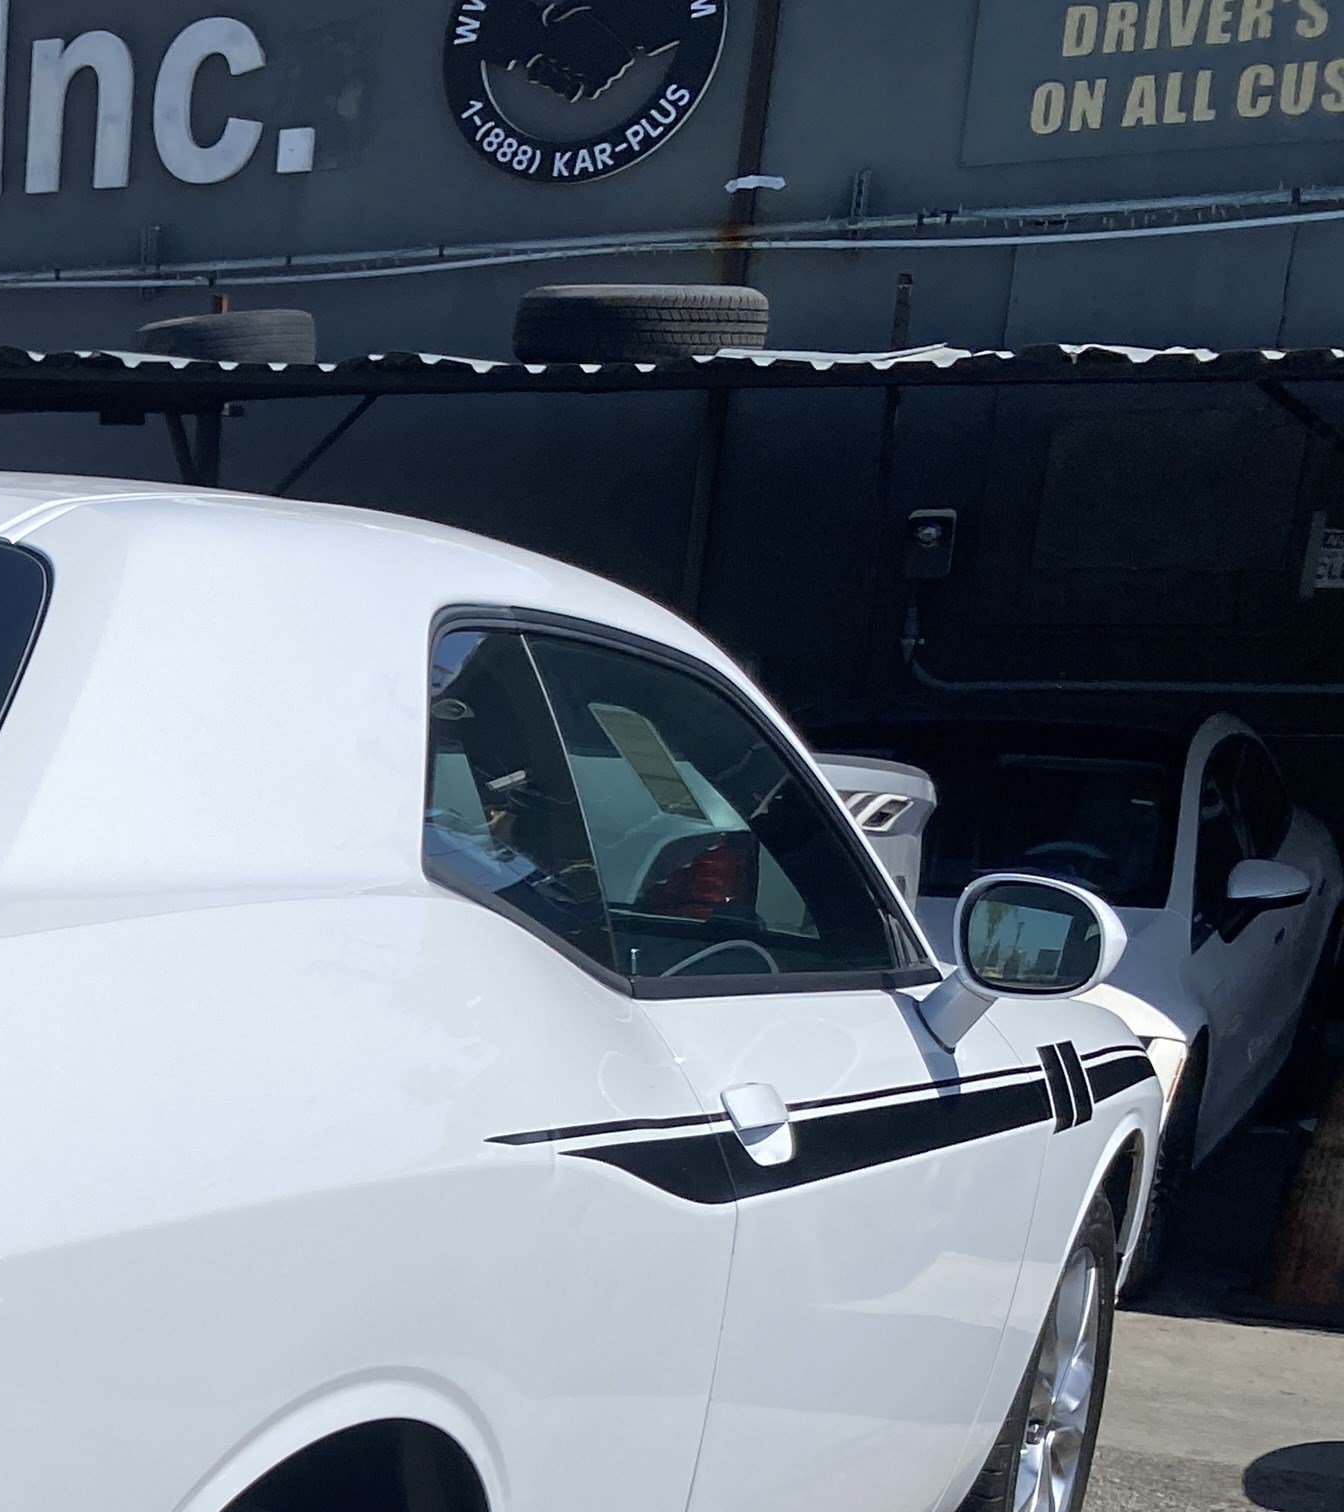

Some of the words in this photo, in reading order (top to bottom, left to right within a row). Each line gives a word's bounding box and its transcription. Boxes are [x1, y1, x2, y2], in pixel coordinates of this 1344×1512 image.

[461, 99, 542, 175] 1-(888)
[551, 83, 691, 178] KAR-PLUS
[1030, 78, 1107, 135] ON
[1121, 69, 1216, 128] ALL
